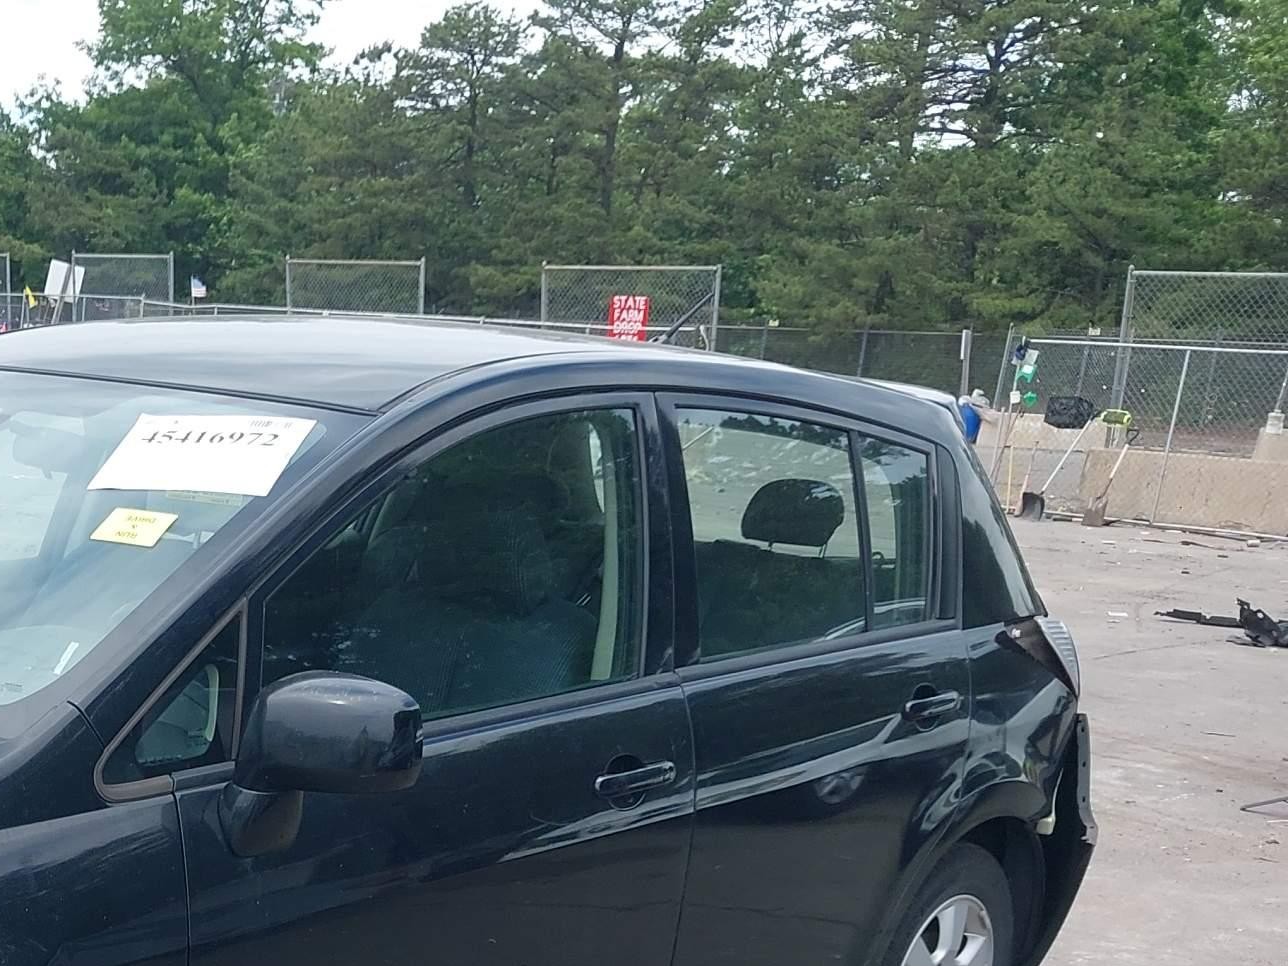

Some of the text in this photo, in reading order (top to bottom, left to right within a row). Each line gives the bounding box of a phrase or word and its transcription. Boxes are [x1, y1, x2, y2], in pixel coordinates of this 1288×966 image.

[613, 296, 647, 310] STATE
[613, 308, 644, 323] FARM
[613, 321, 642, 335] DROP
[141, 430, 280, 447] 45416972
